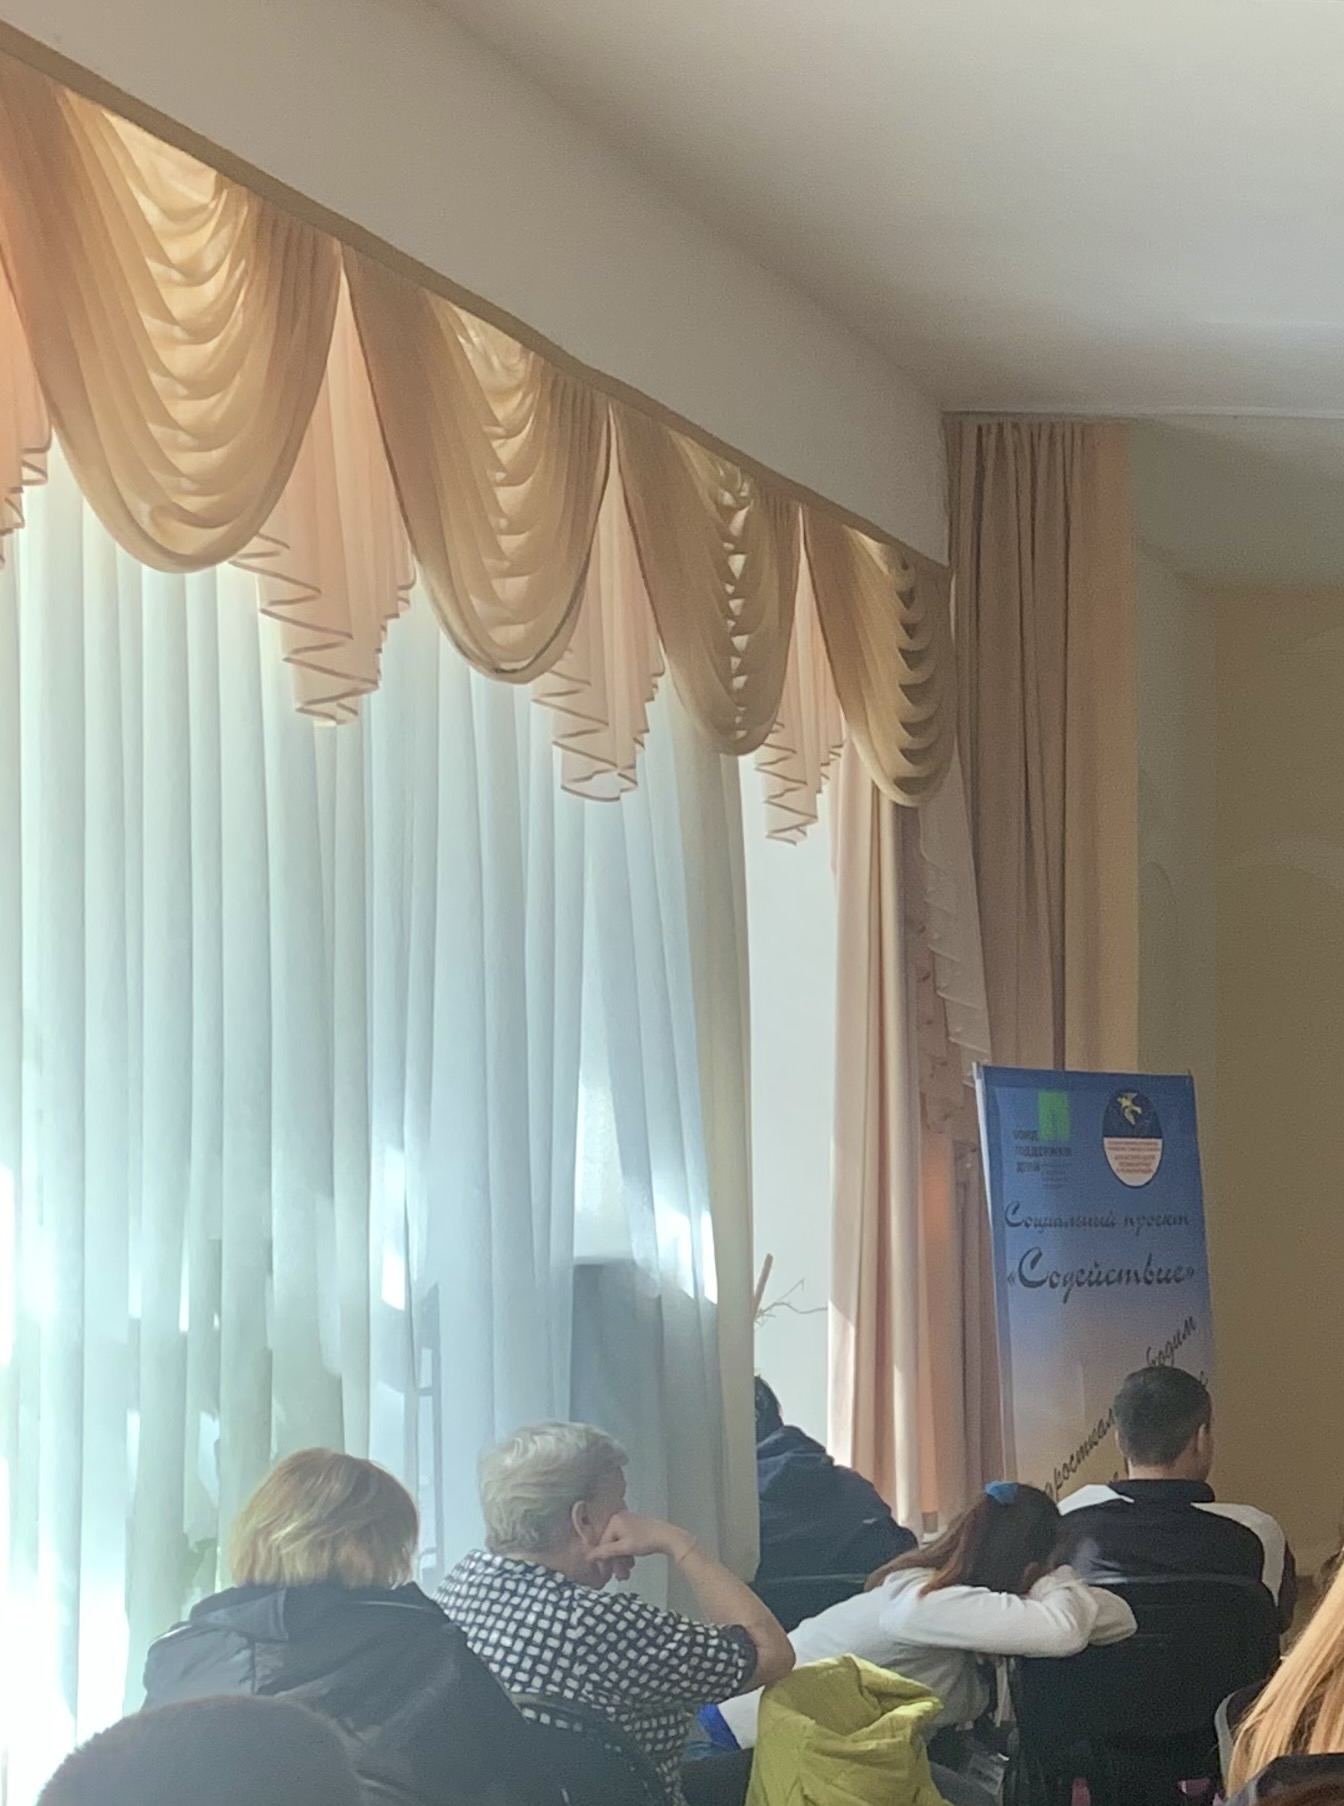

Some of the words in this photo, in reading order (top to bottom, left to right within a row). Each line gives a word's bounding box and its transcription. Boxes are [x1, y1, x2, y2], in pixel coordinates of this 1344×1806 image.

[1004, 1201, 1116, 1233] Социальный
[1124, 1212, 1190, 1236] проект
[1007, 1246, 1195, 1304] «Содействие»
